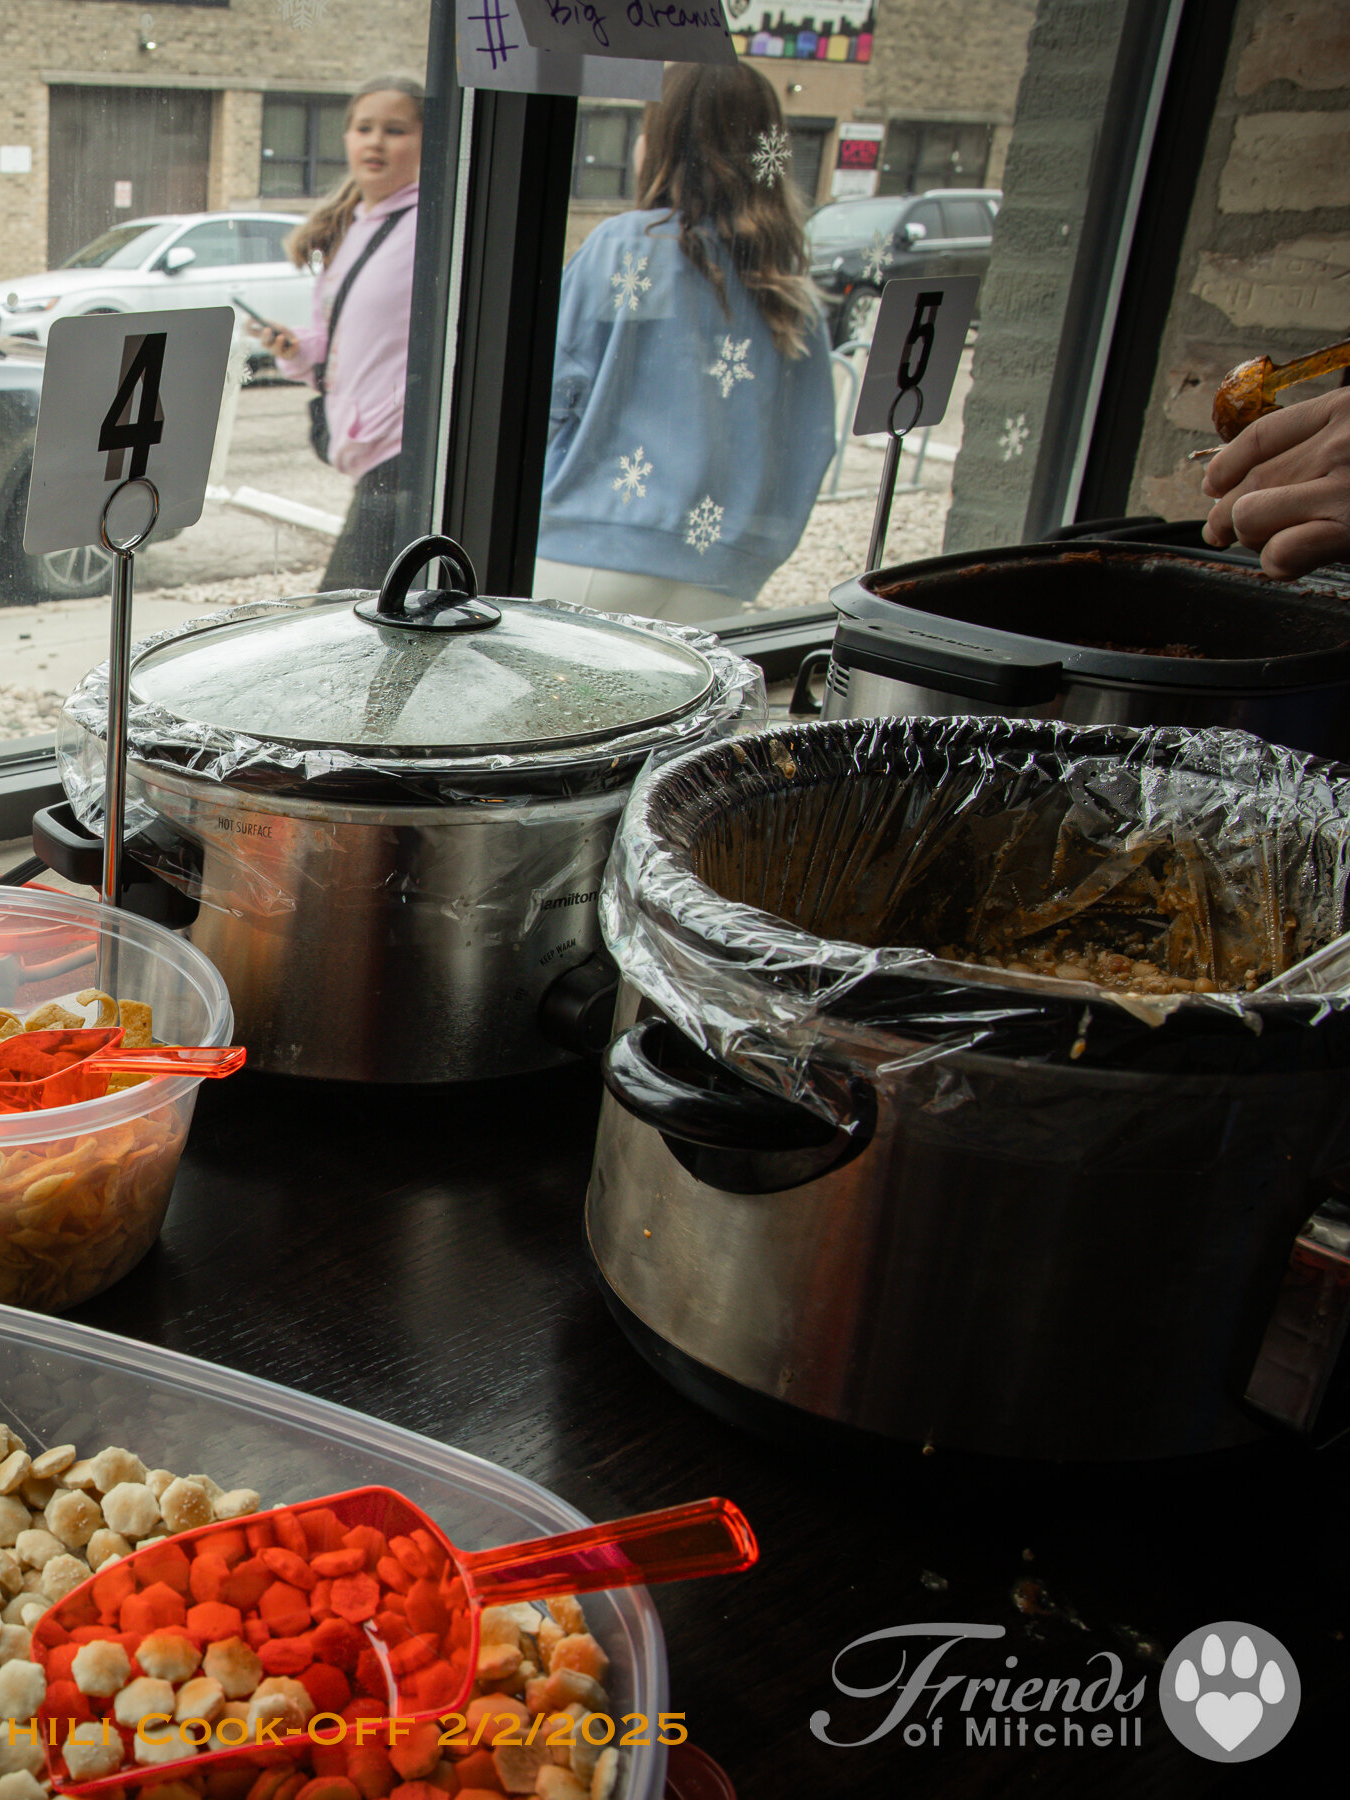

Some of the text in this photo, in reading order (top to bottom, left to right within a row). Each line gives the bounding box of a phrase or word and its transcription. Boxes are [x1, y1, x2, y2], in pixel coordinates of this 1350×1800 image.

[97, 332, 167, 478] 4
[218, 817, 273, 838] HOT SURFACE
[538, 938, 576, 966] KEEP WARM
